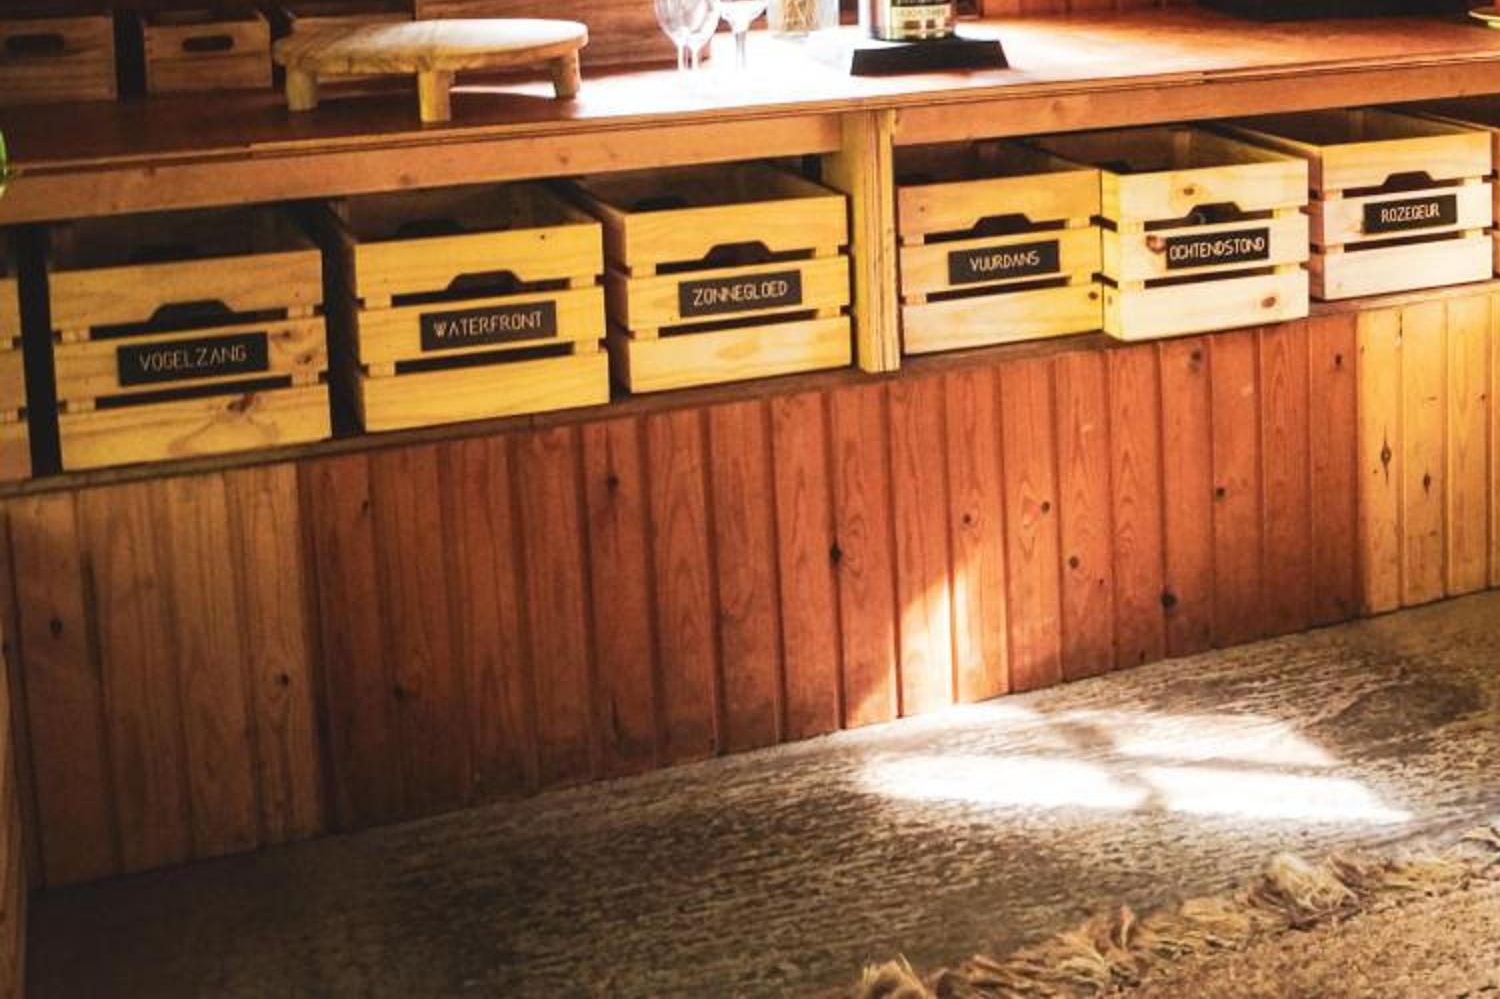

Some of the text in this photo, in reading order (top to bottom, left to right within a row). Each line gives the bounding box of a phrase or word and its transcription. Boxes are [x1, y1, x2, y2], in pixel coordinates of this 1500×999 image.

[1380, 202, 1441, 223] ROZEGEUR
[1169, 236, 1265, 261] OCHTENDSTOND
[968, 250, 1041, 273] VUURDANS
[691, 280, 789, 306] ZONNEGLOED
[433, 311, 543, 338] WATERFRONT
[138, 343, 248, 372] VOGELZANG
